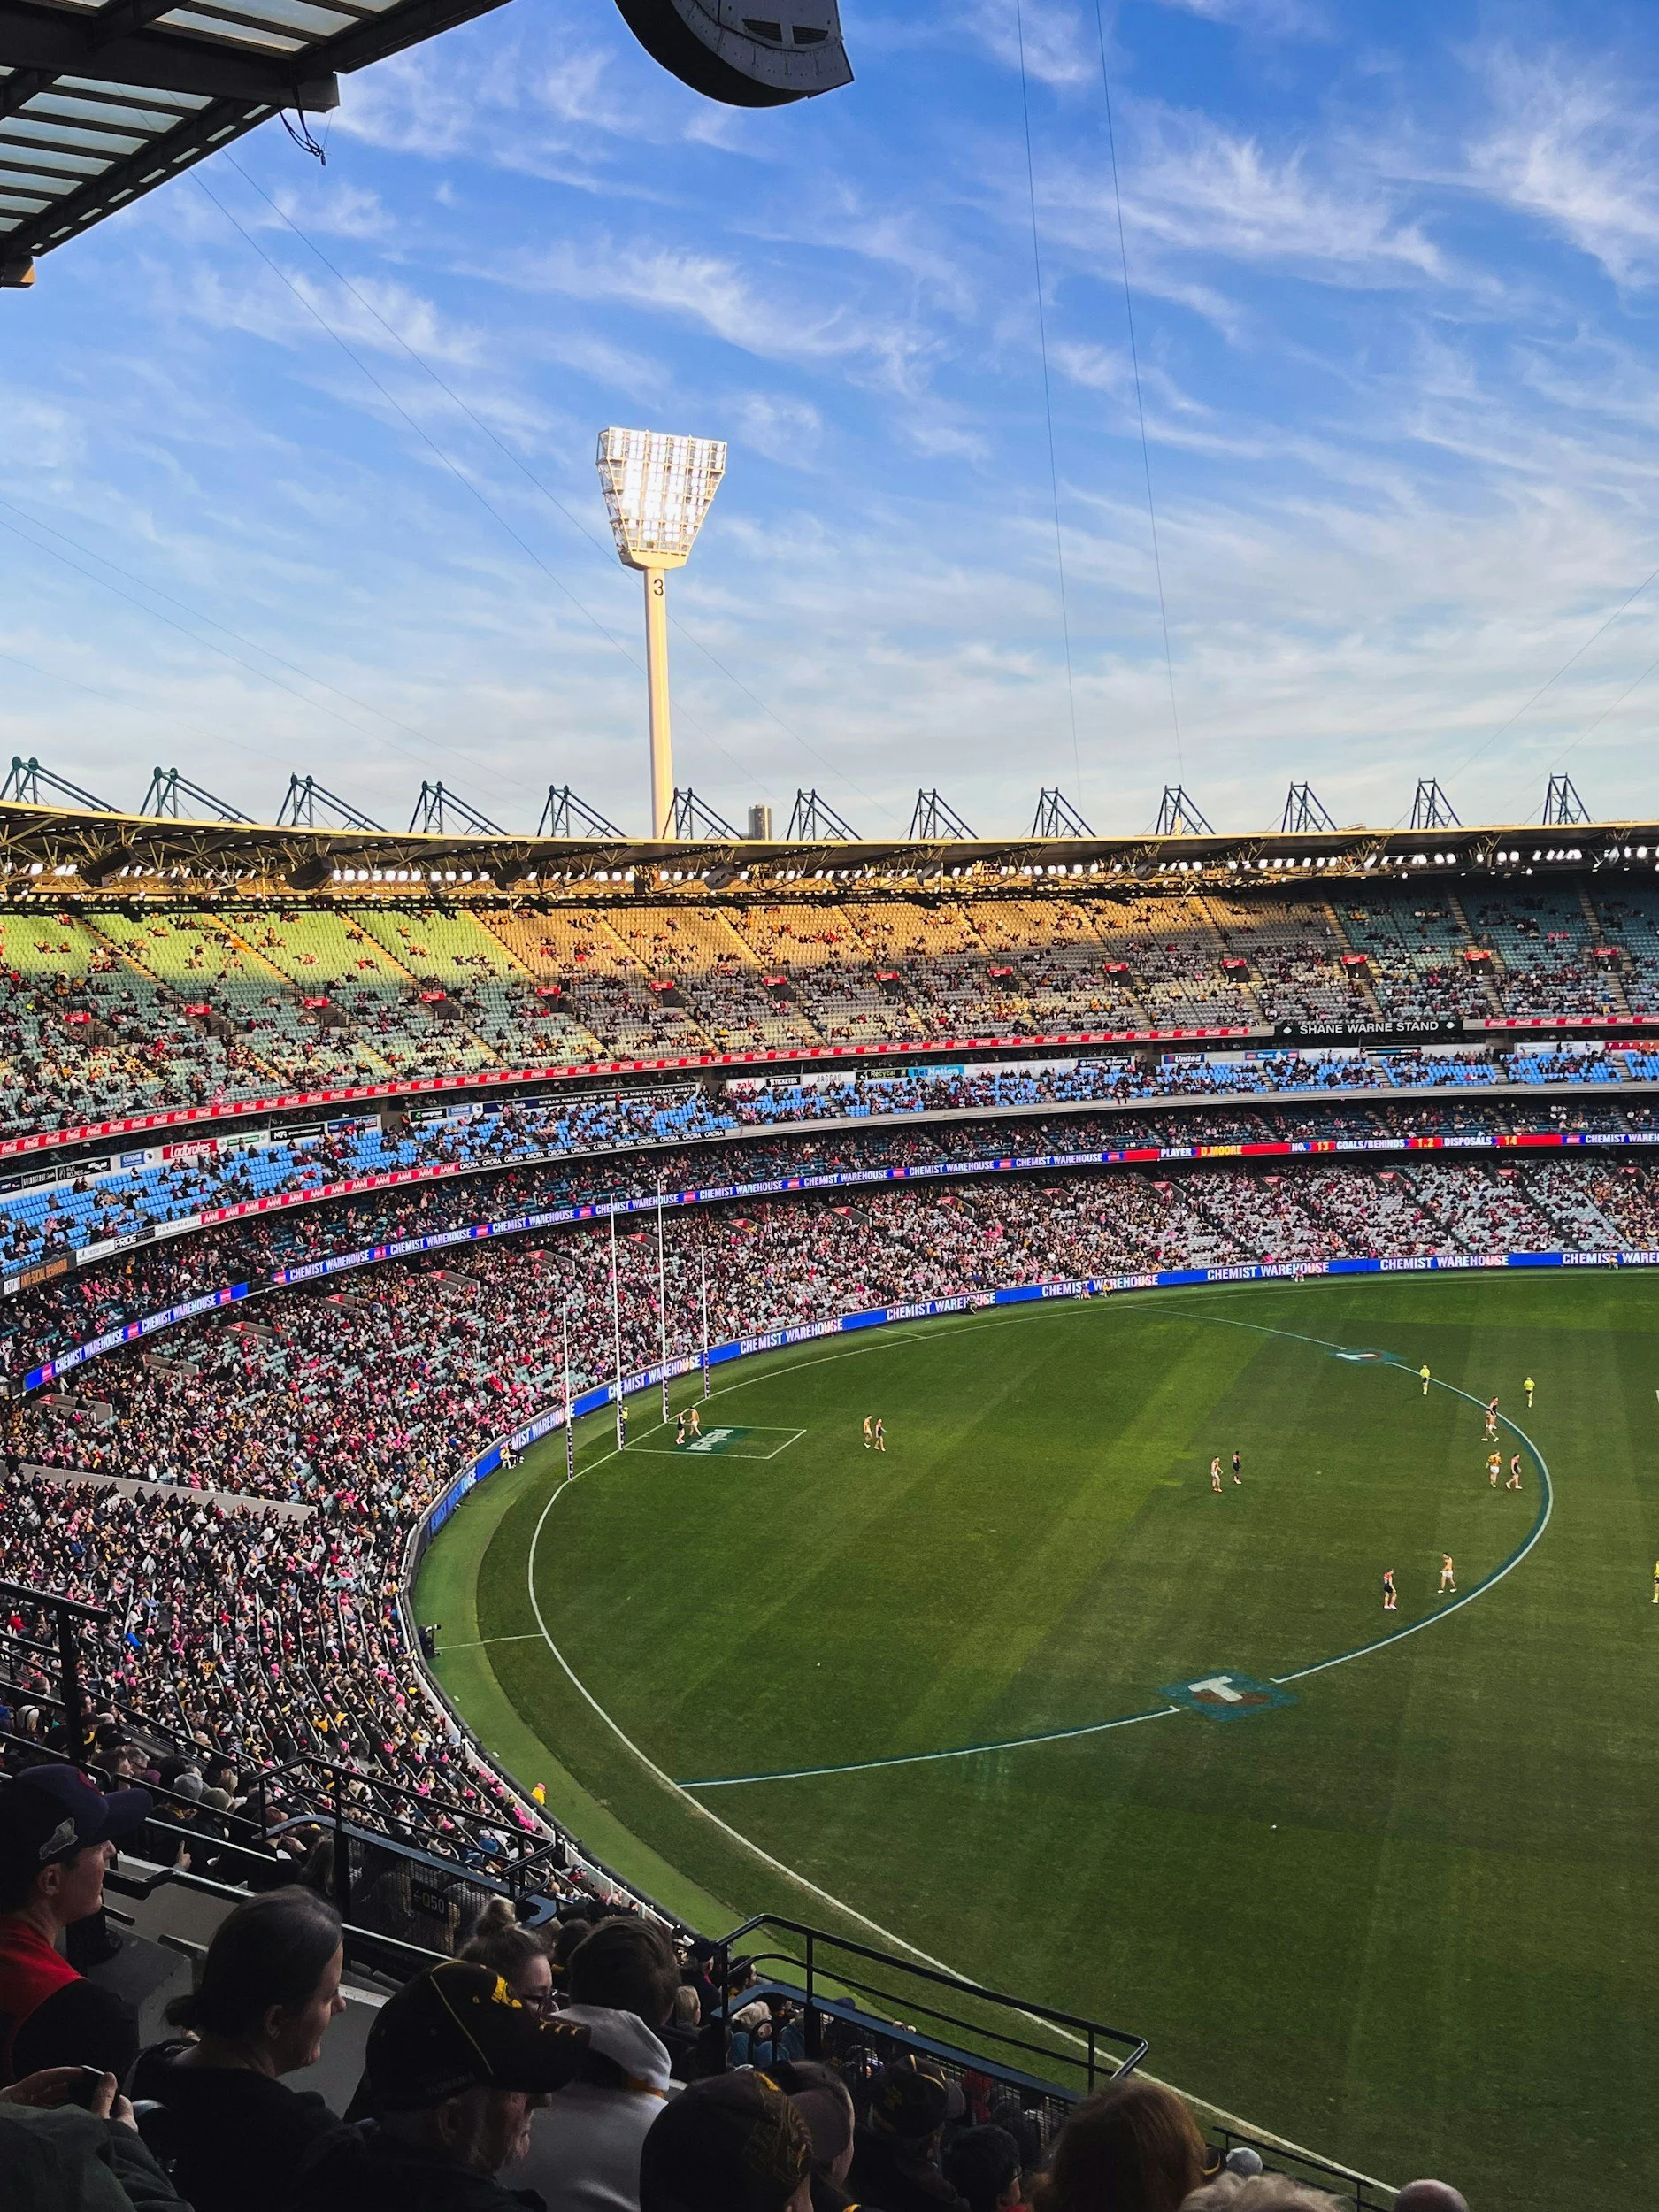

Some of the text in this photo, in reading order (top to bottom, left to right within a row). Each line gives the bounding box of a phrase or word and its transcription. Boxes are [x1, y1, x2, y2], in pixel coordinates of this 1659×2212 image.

[653, 578, 664, 596] 3
[1300, 1021, 1439, 1035] SHANE WARNE STAND
[913, 1066, 959, 1077] BetNation
[1317, 1141, 1329, 1151] 13
[1336, 1138, 1434, 1150] GOALS/BEHINDS 1.2
[1444, 1136, 1517, 1147] DISPOSALS 14
[1586, 1134, 1625, 1144] CHEMIST
[170, 1142, 211, 1158] Ladbrokes
[1161, 1145, 1242, 1158] PLAYER D.MOORE
[910, 1160, 995, 1176] CHEMIST WAREHOUSE
[1016, 1152, 1102, 1167] CHEMIST WAREHOUSE
[803, 1169, 888, 1187] CHEMIST WAREHOUSE
[204, 1164, 455, 1223] AAMI AAMI AAMI AAMI AAMI AAMI AAMI AAMI AAMI AAMI AAMI AAMI
[699, 1180, 783, 1200] CHEMIST WAREHOUSE
[595, 1194, 679, 1215] CHEMIST WAREHOUSE
[492, 1210, 574, 1233] CHEMIST WAREHOUSE
[115, 1233, 137, 1248] PRIDE
[390, 1227, 472, 1256] CHEMIST WAREHOUSE
[290, 1249, 369, 1280] CHEMIST WAREHOUSE
[1207, 1262, 1330, 1281] CHEMIST WAREHOUSE
[1380, 1255, 1509, 1270] CHEMIST WAREHOUSE
[142, 1310, 173, 1333] CHEMIST
[173, 1294, 216, 1319] WAREHOUSE
[887, 1292, 995, 1321] CHEMIST WAREHUSE
[740, 1317, 843, 1355] CHEMIST WAREHOUSE
[55, 1348, 82, 1374] CHEMIST
[83, 1328, 125, 1357] WAREHOUSE
[532, 1402, 576, 1440] WAREHOUE
